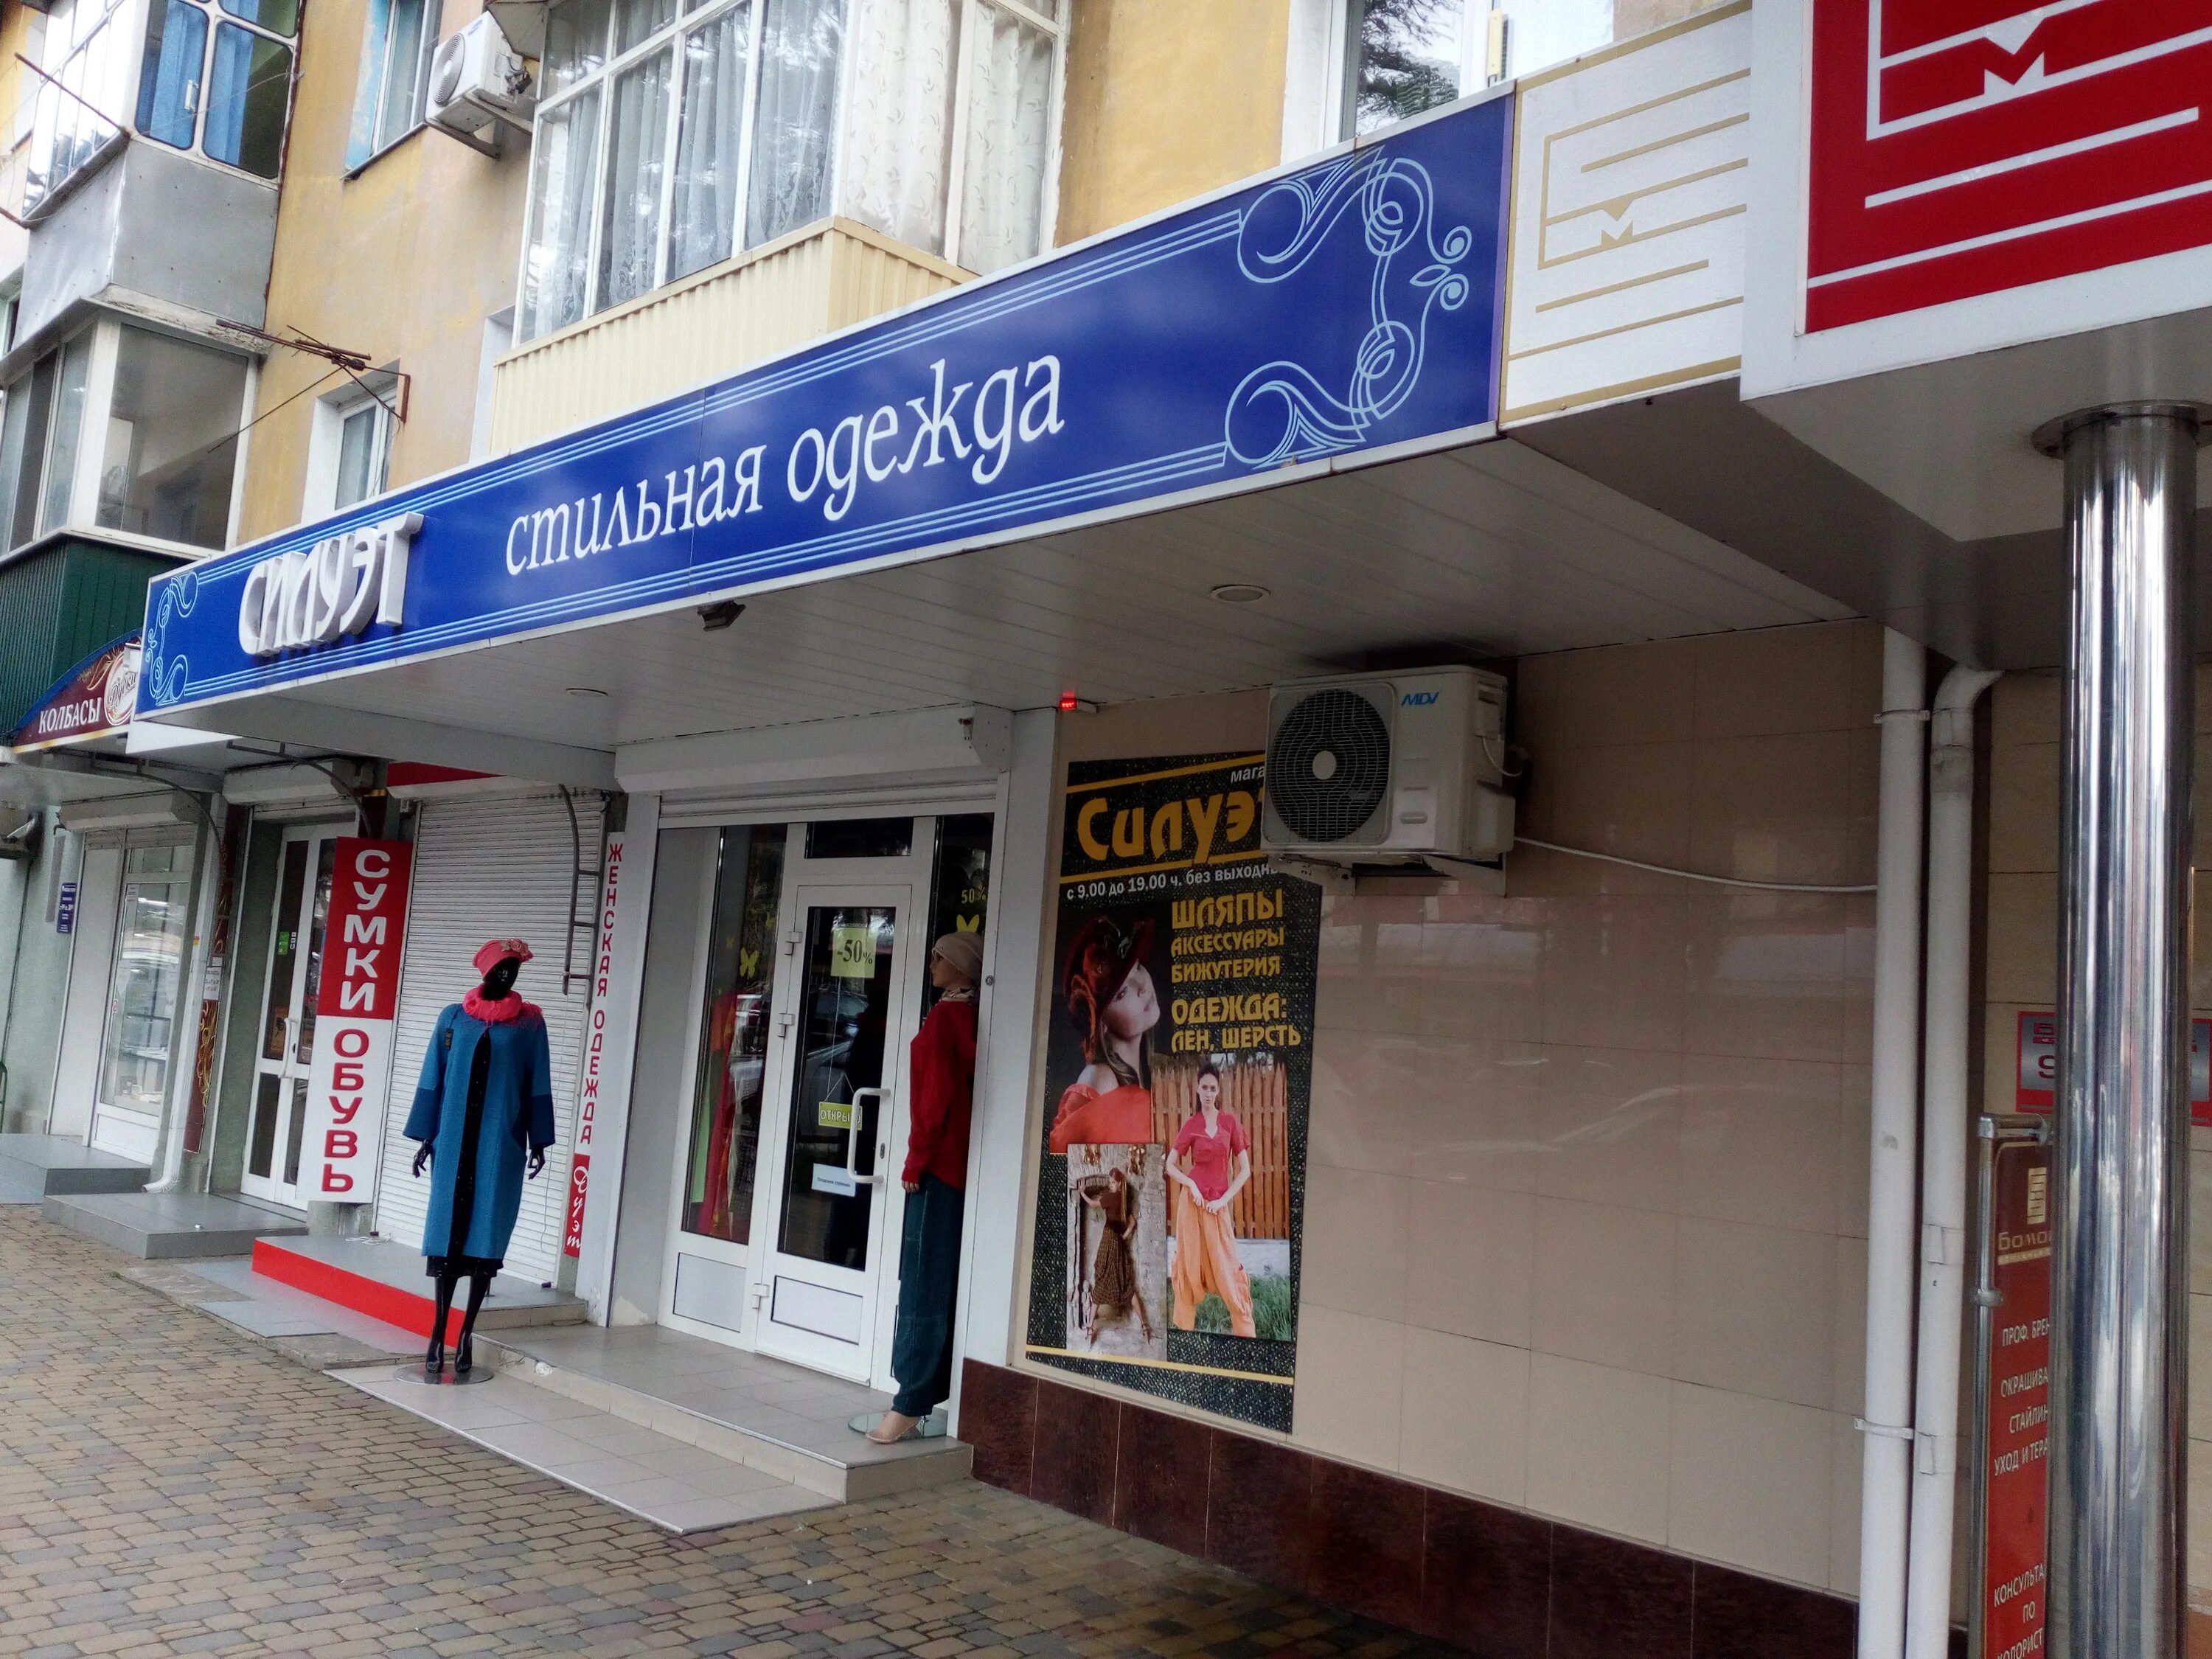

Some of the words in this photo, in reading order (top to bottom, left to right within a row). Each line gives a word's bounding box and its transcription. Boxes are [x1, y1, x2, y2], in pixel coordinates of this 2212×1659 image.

[505, 445, 768, 576] стильная
[787, 354, 1065, 522] одежда
[1401, 692, 1440, 706] MDV
[38, 697, 102, 734] КОЛБАСЫ
[1077, 786, 1265, 865] Силуэ
[1078, 880, 1106, 899] 9.00
[1108, 881, 1124, 897] до
[1127, 873, 1166, 893] 19.00
[1170, 874, 1182, 887] ч.
[1186, 870, 1211, 886] без
[597, 843, 624, 997] ЖЕНСКАЯ
[1172, 888, 1283, 930] ШЛЯПЫ
[338, 849, 390, 1012] СУМКИ
[1170, 926, 1284, 957] АКСЕССУАРЫ
[1171, 956, 1281, 984] БИЖУТЕРИЯ
[1171, 992, 1287, 1025] ОДЕЖДА:
[1222, 1024, 1301, 1050] ШЕРСТЬ
[580, 1009, 605, 1144] ОДЕЖДА
[321, 1029, 369, 1192] ОБУВЬ
[820, 1109, 861, 1124] ОТКРЫ
[2002, 1324, 2029, 1347] ПРОФ.
[1994, 1450, 2019, 1477] УХОД
[2022, 1445, 2029, 1464] И
[2023, 1600, 2036, 1624] ПО
